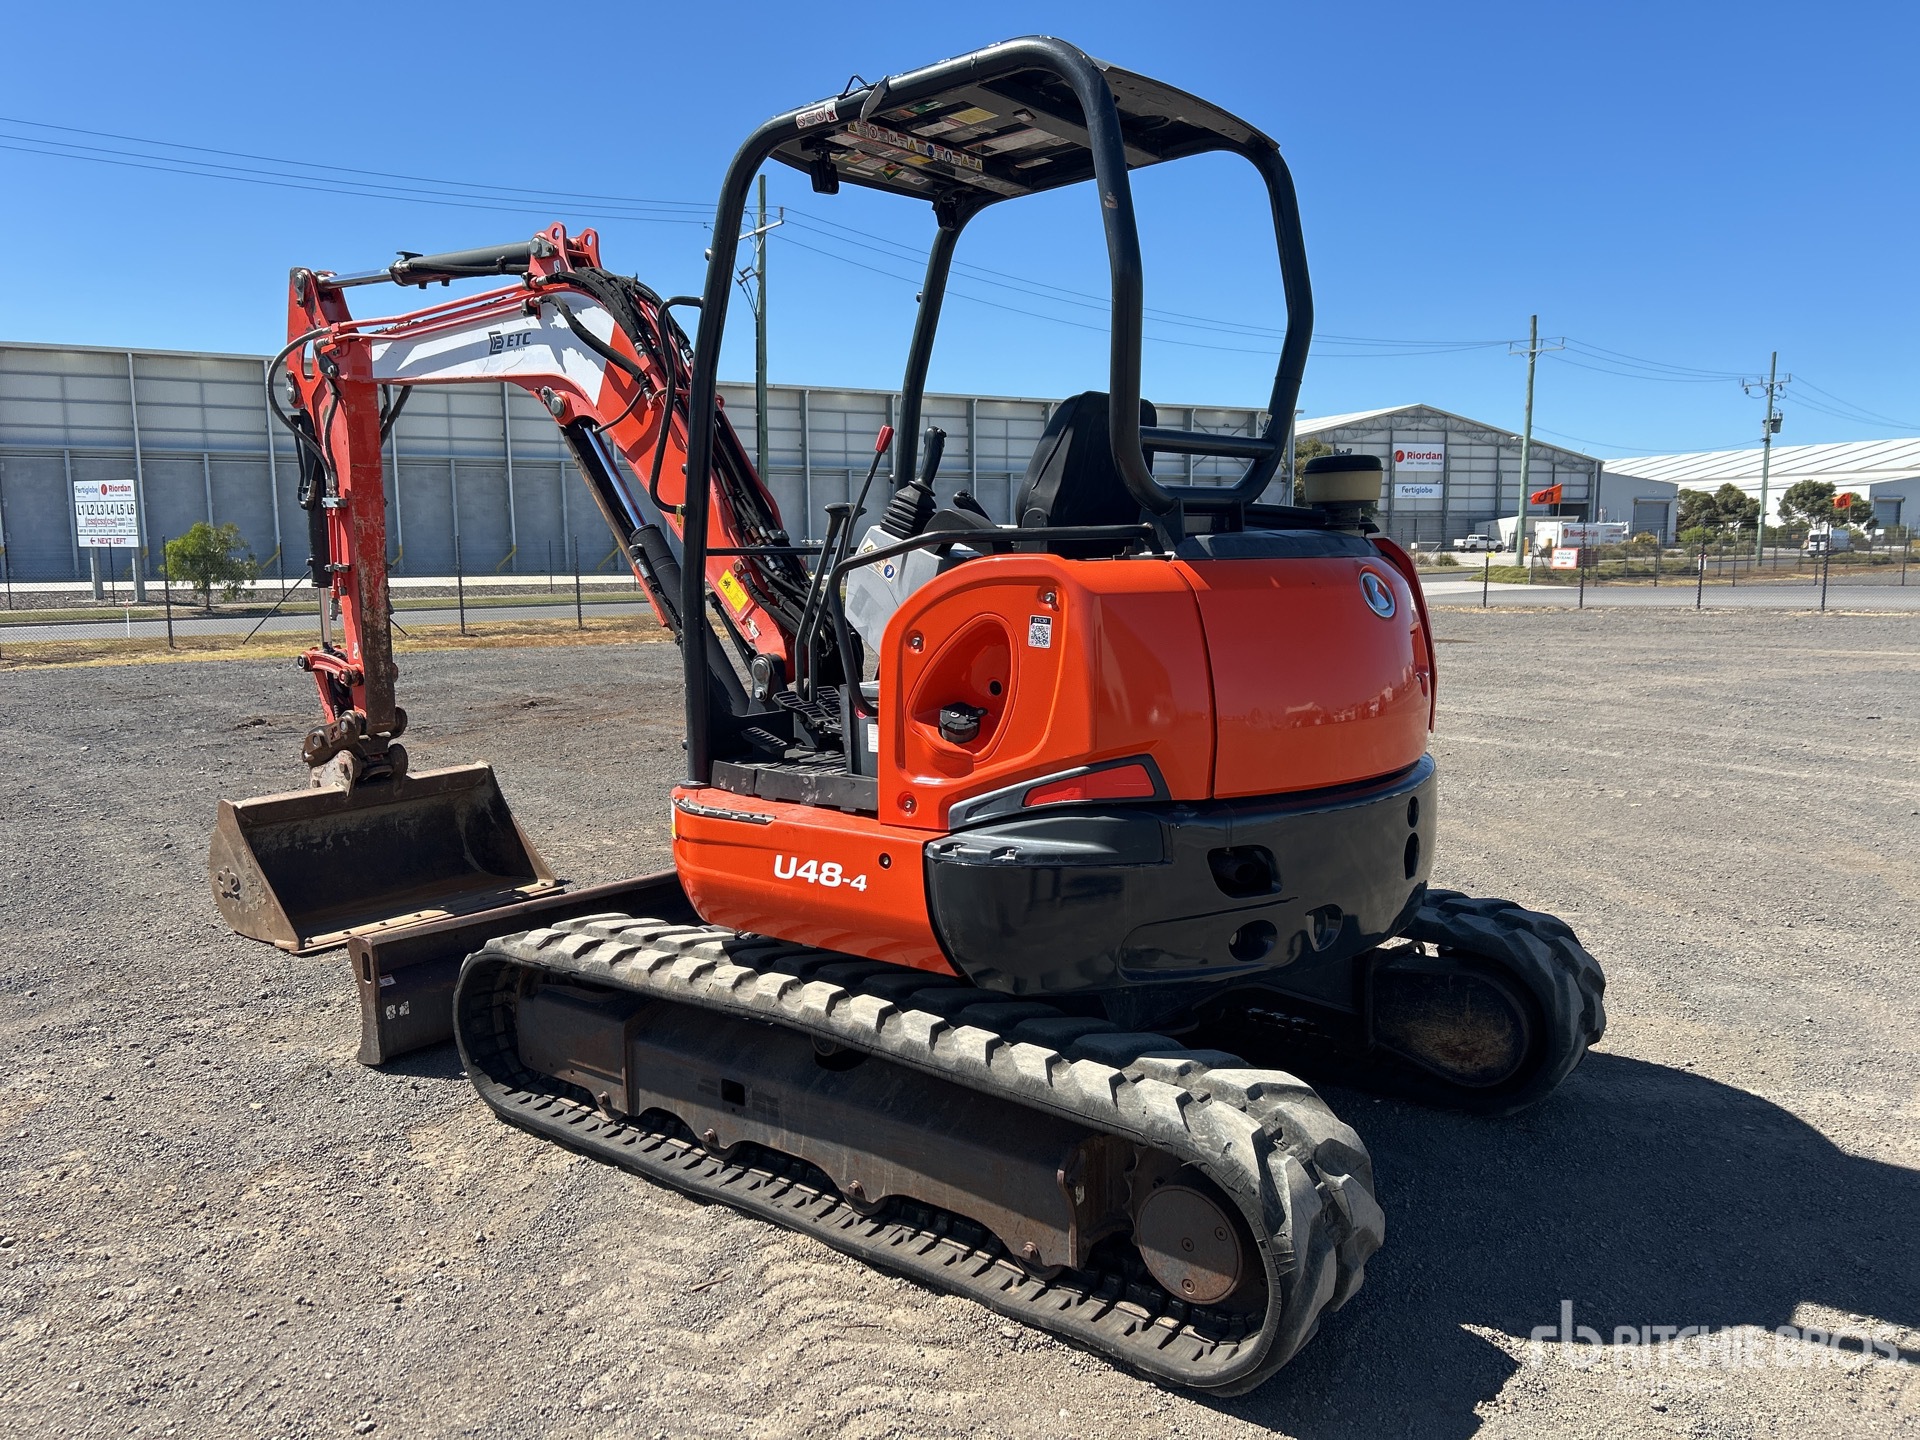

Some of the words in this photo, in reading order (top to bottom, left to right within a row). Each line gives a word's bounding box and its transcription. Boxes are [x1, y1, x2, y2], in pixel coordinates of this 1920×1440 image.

[507, 332, 531, 347] ETC
[1407, 451, 1442, 460] Riordan
[108, 484, 132, 492] Riordan
[1402, 486, 1433, 494] Fertiglobe
[78, 504, 85, 515] L1
[87, 504, 94, 515] L2
[97, 504, 104, 515] L3
[107, 504, 114, 515] L4
[117, 504, 124, 515] L5
[127, 504, 134, 515] L6
[774, 854, 867, 892] U48-4
